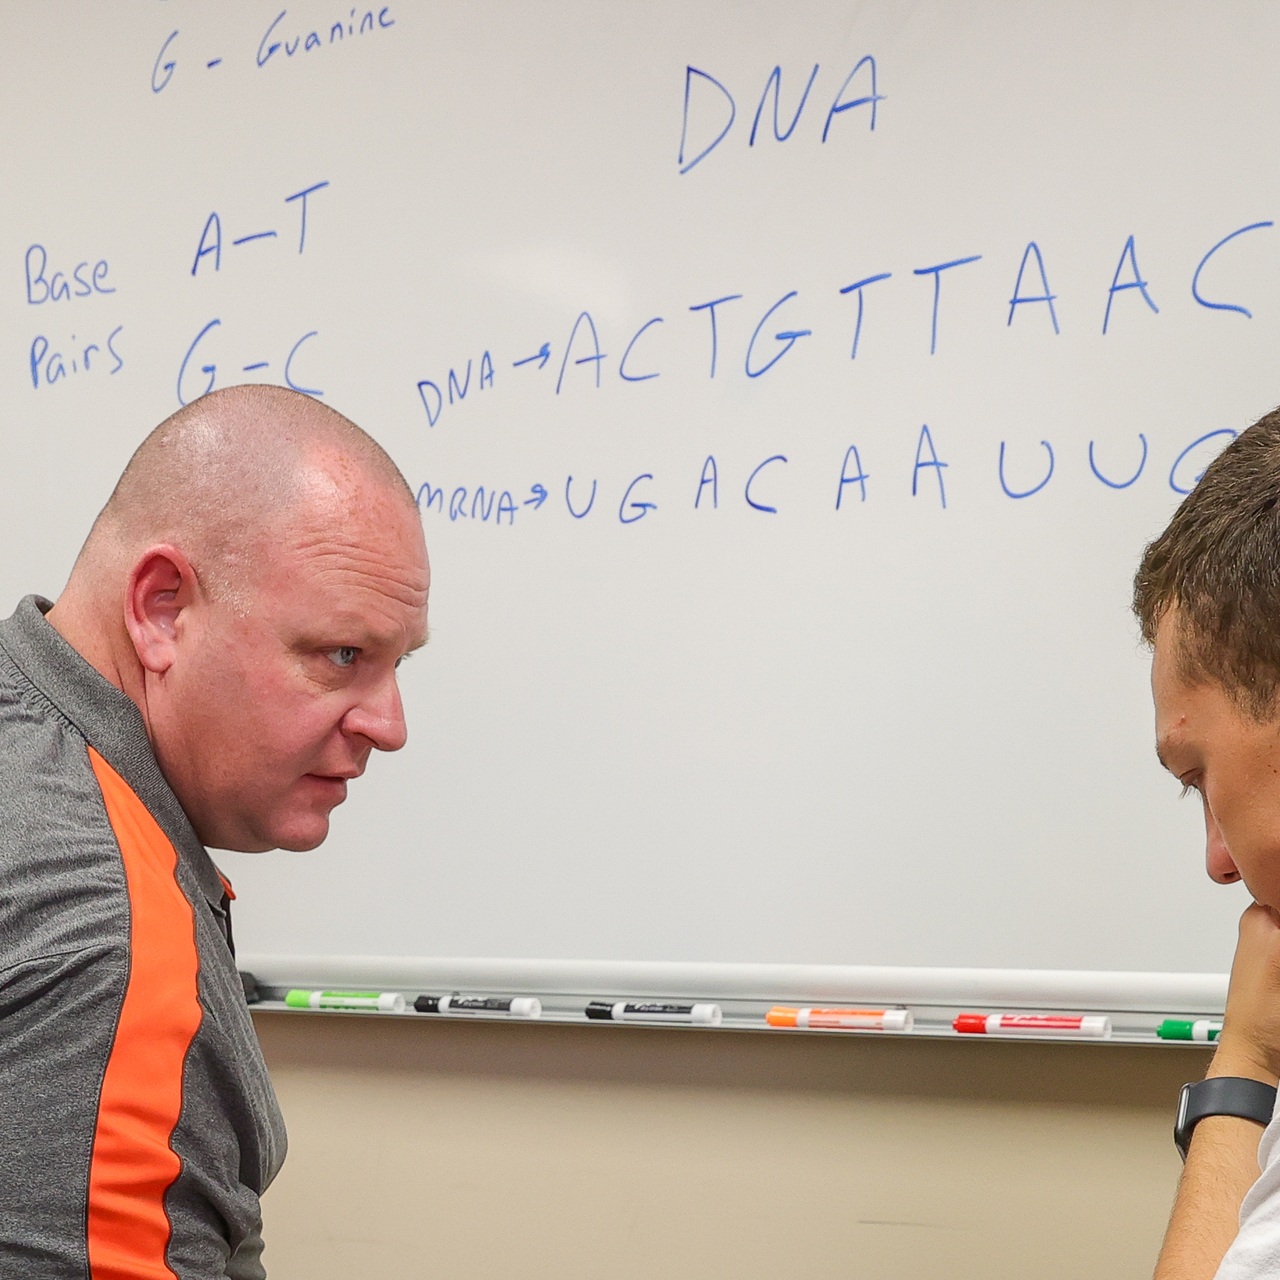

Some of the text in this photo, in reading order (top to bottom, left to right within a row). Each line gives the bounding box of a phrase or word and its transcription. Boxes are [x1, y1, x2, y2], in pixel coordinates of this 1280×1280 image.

[677, 54, 888, 175] DNA
[25, 243, 117, 304] Base
[31, 326, 123, 388] Pairs
[417, 351, 495, 427] DNA
